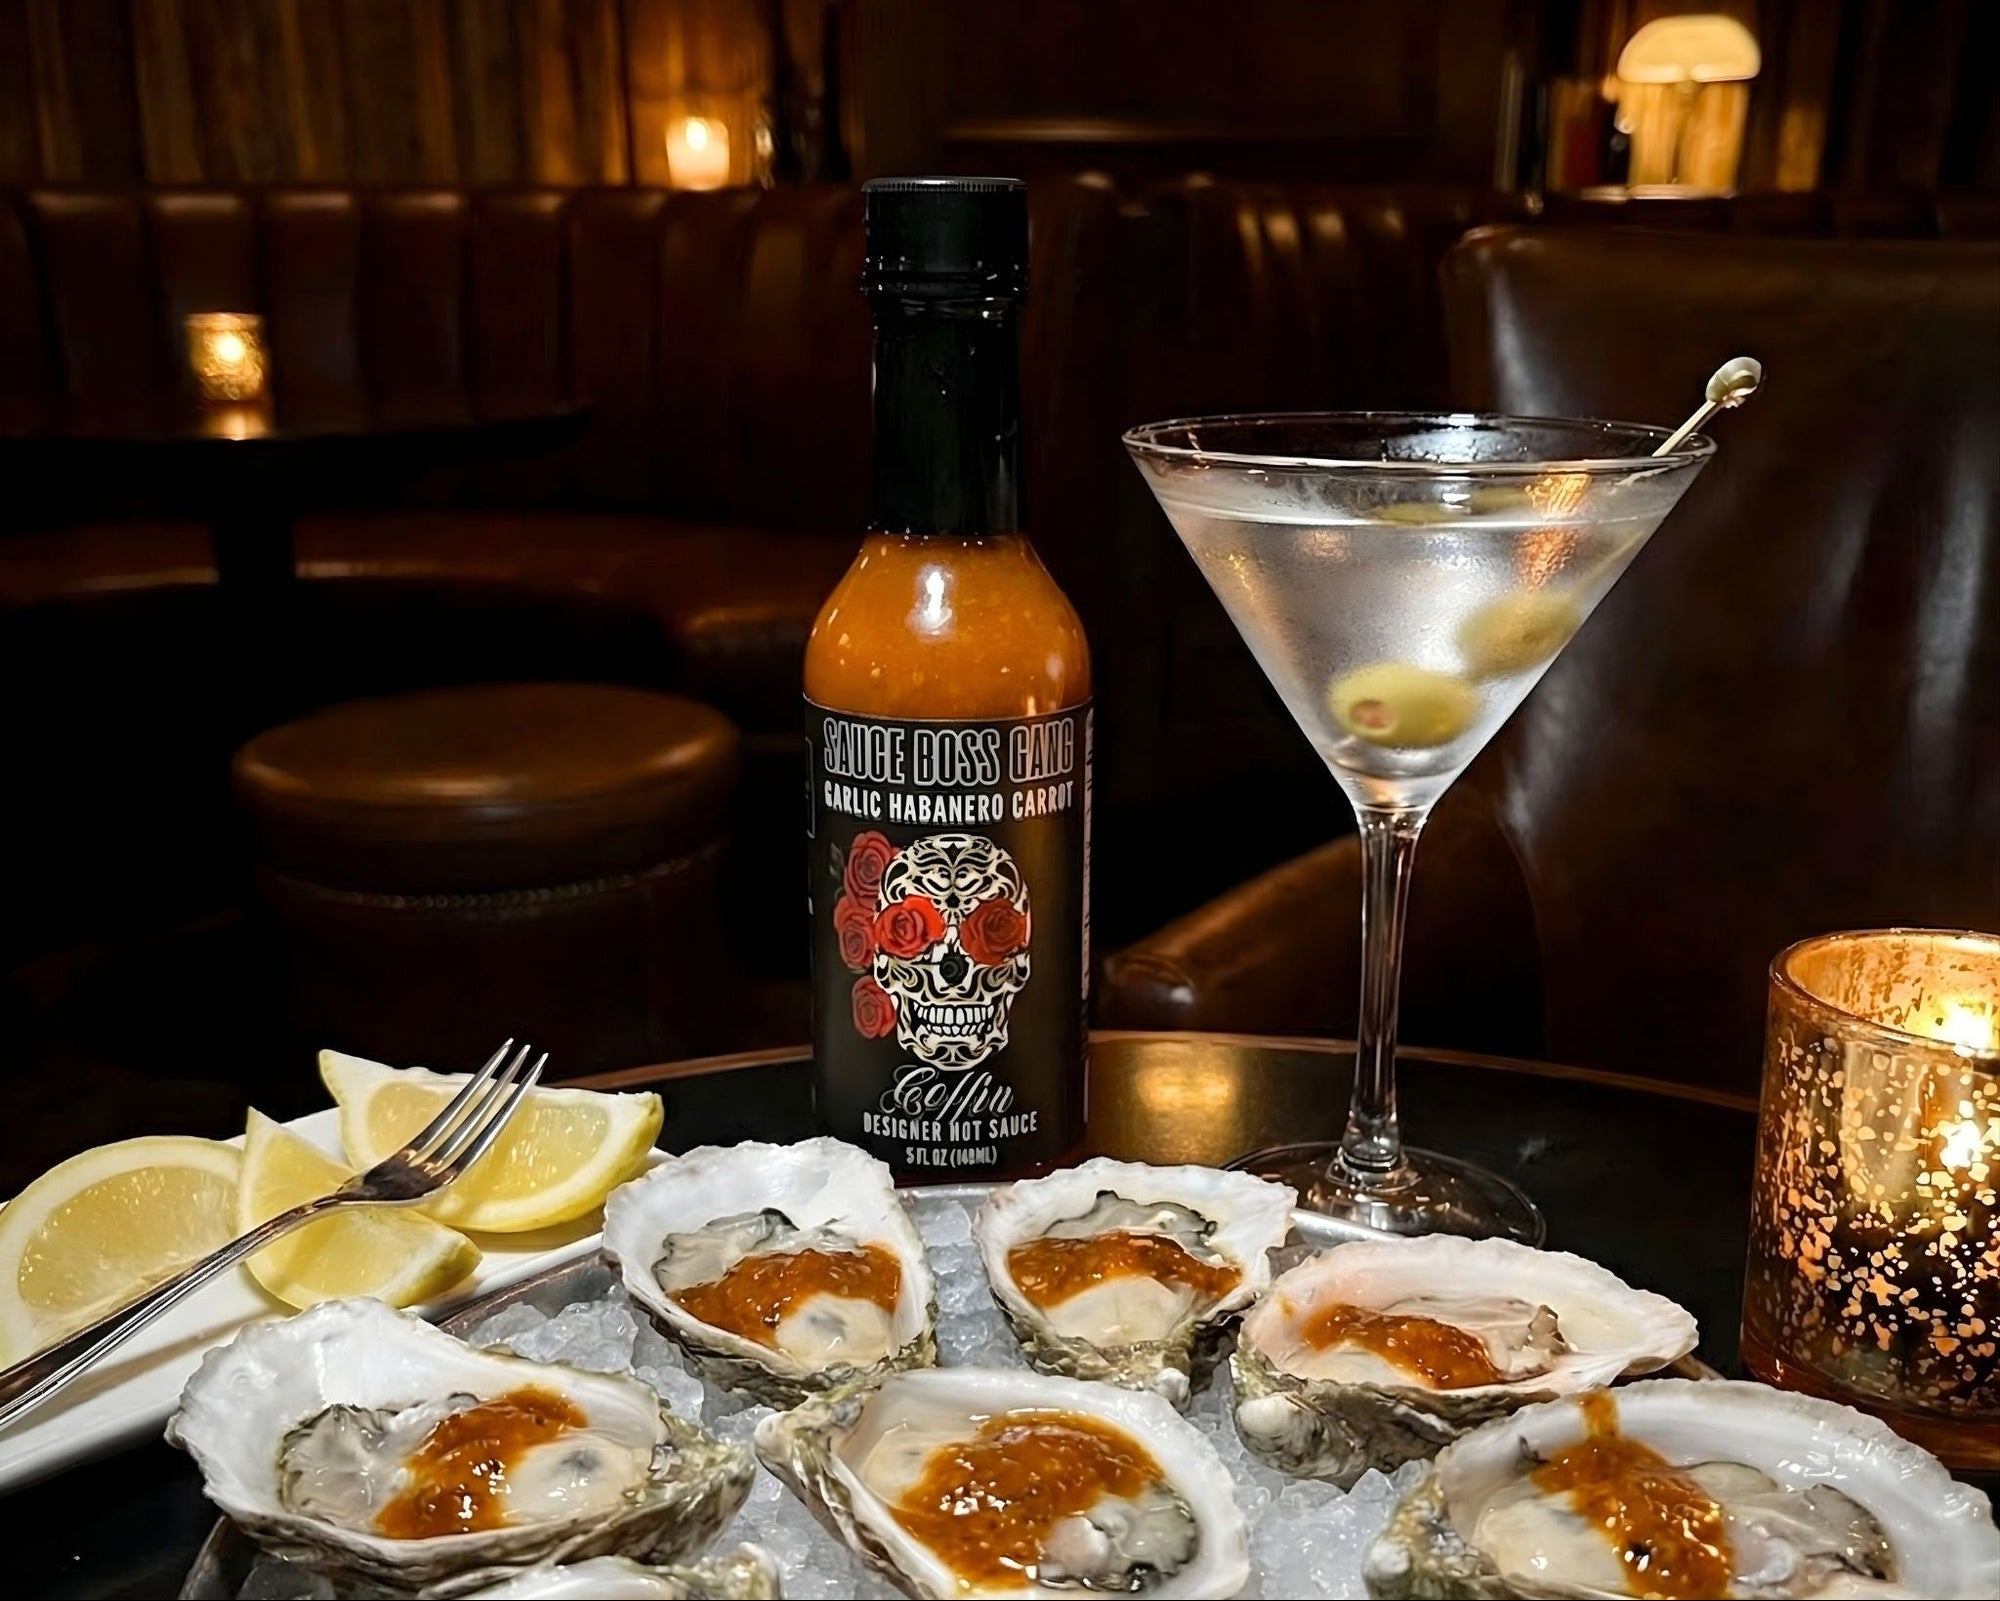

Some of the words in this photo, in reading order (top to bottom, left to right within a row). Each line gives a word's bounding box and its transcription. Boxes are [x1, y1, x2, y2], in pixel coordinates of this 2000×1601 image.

[823, 717, 905, 785] SAUCE
[914, 729, 1000, 787] BOSS
[1009, 718, 1075, 783] GANG
[824, 780, 881, 819] GARLIC
[889, 792, 1004, 824] HABANERO
[1012, 781, 1073, 820] CARROT
[879, 1065, 1014, 1121] Coffin
[863, 1111, 942, 1142] DESIGNER
[950, 1120, 982, 1142] HOT
[988, 1111, 1038, 1140] SAUCE
[905, 1146, 915, 1165] 5
[932, 1148, 948, 1166] OZ
